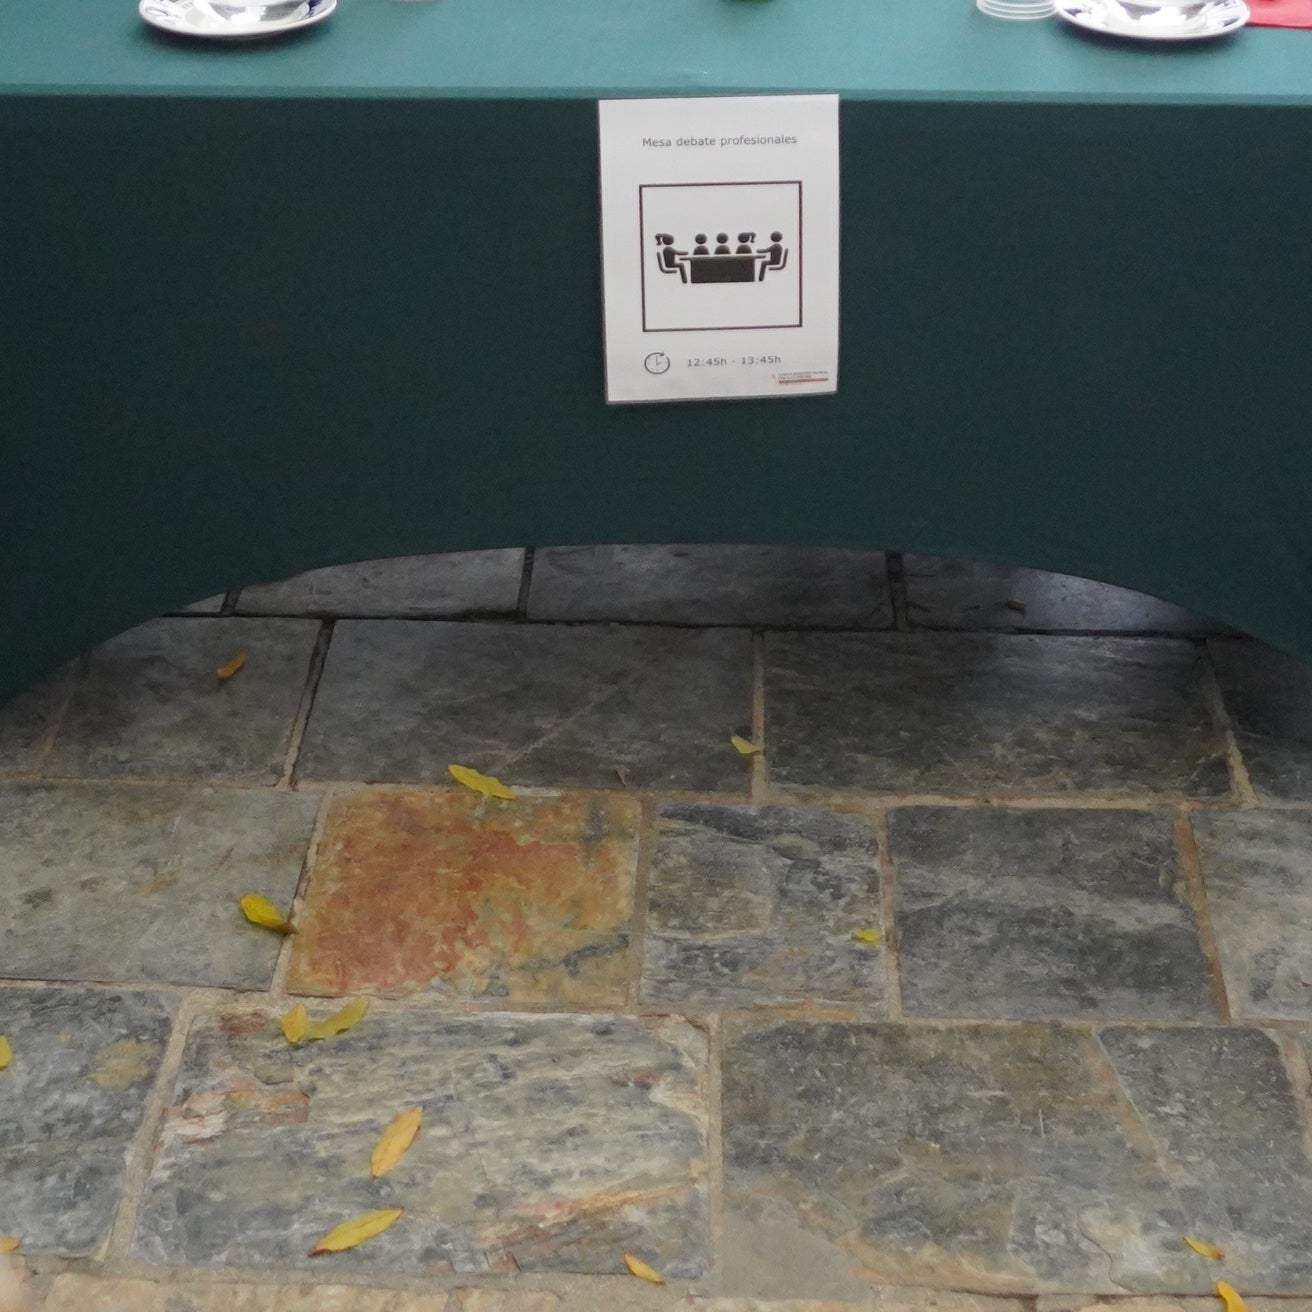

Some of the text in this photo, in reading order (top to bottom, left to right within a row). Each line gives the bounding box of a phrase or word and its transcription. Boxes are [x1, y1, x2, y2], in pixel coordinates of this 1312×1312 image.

[642, 134, 798, 147] Mesa debate profesionales
[687, 357, 727, 367] 12:45h
[741, 355, 782, 365] 13:45h
